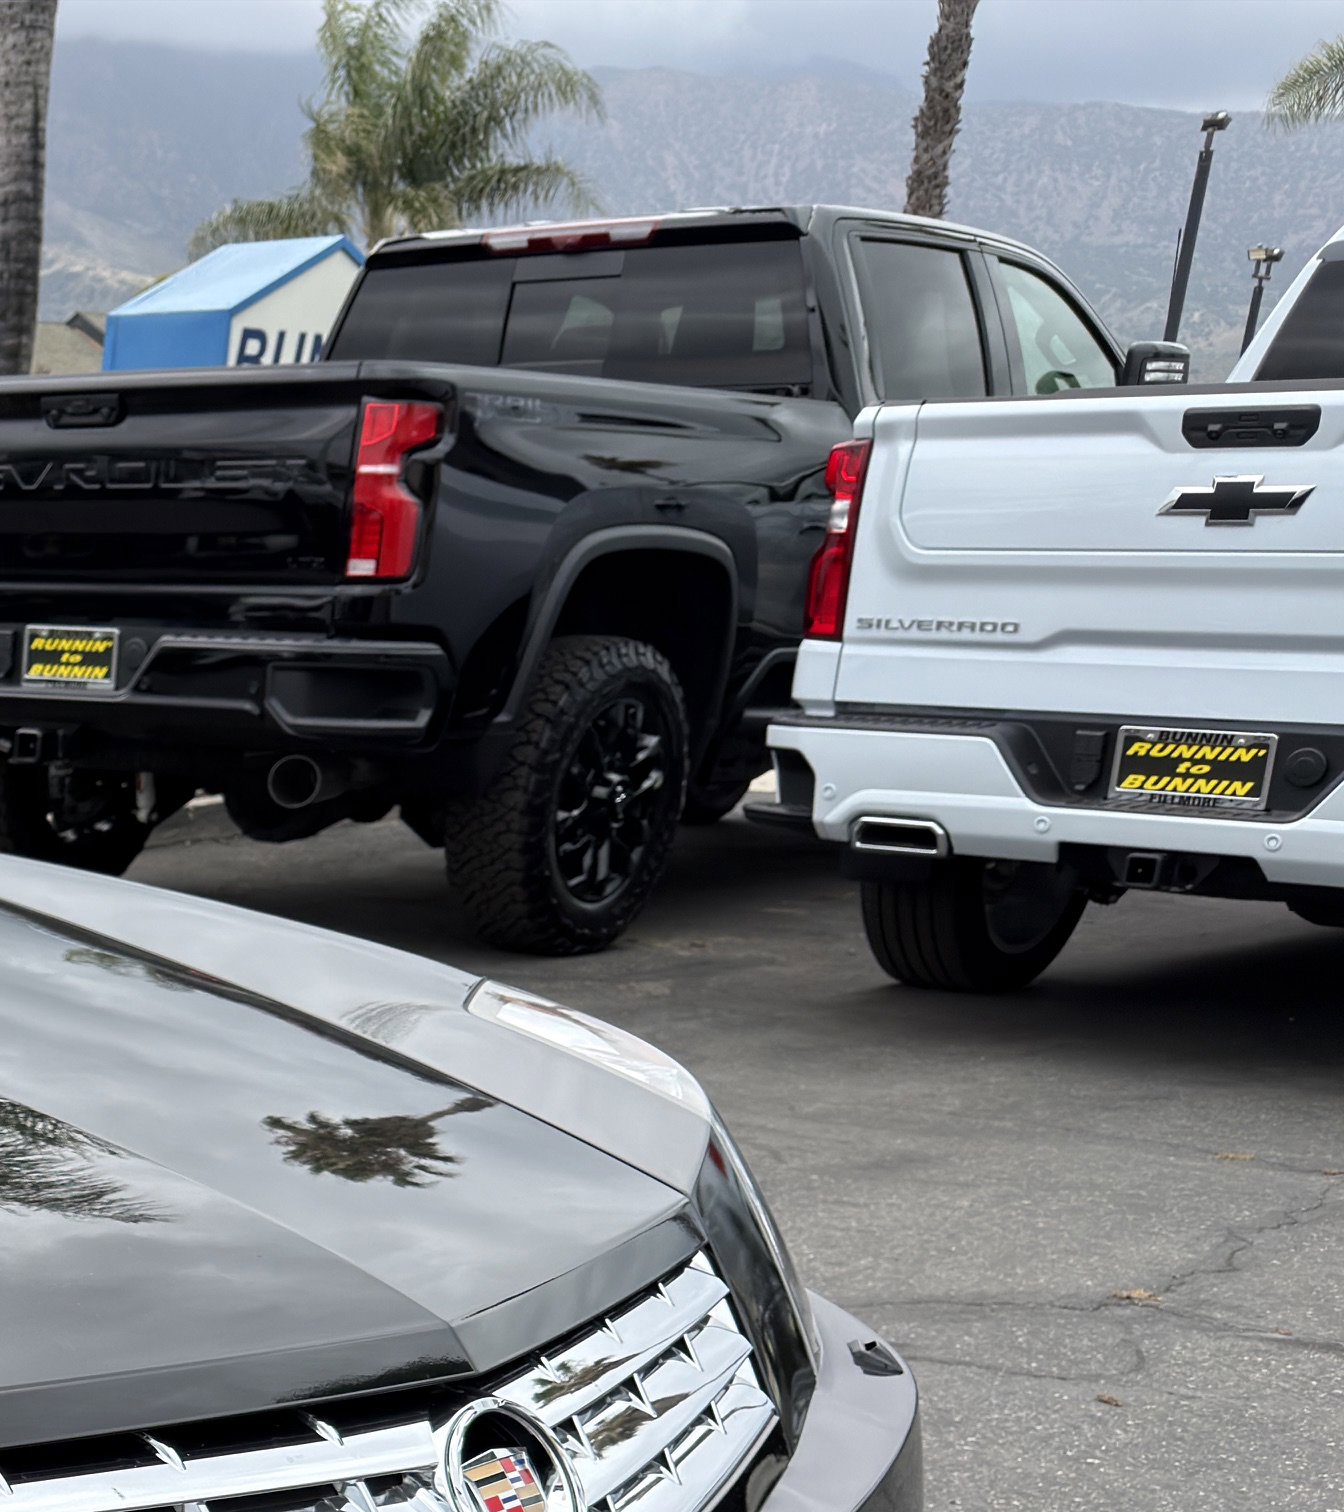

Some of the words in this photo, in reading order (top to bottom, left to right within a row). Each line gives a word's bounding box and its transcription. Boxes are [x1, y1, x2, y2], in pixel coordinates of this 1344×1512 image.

[856, 617, 1020, 634] SILVERADO
[28, 663, 109, 679] BUNNIN
[1158, 731, 1235, 746] BUNNIN
[1126, 741, 1267, 762] RUNNIN'
[1175, 761, 1212, 775] to
[1120, 774, 1256, 796] BUNNIN
